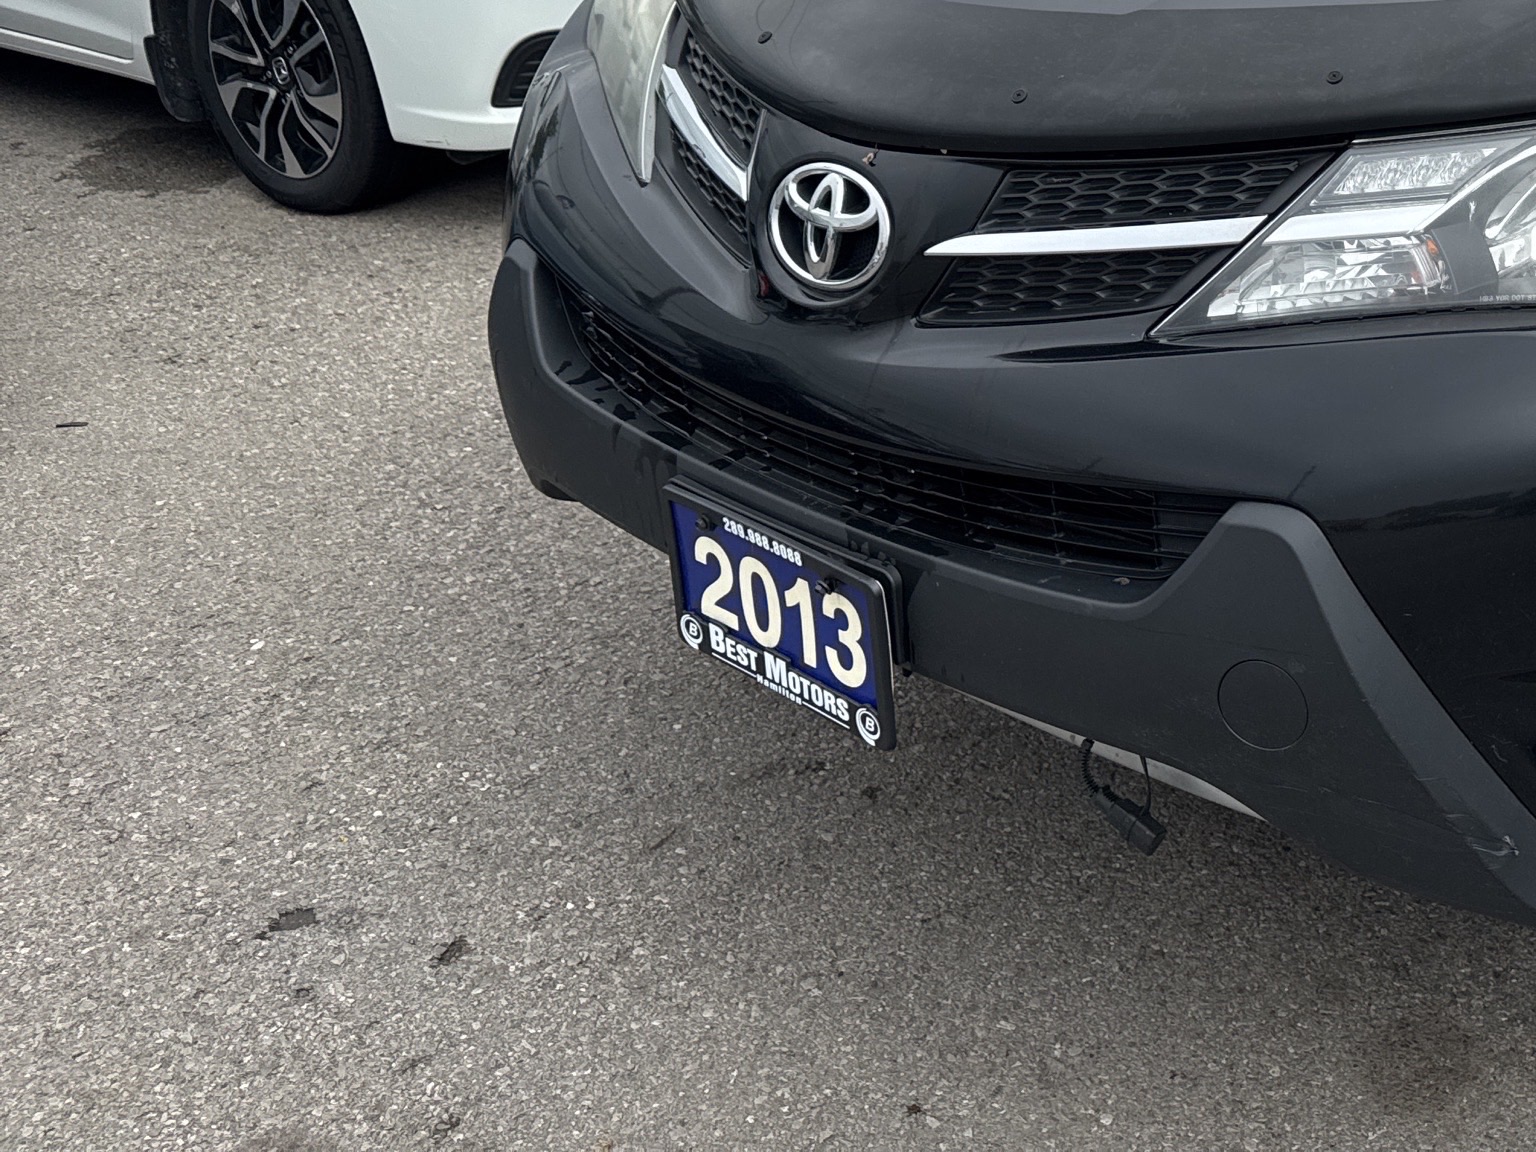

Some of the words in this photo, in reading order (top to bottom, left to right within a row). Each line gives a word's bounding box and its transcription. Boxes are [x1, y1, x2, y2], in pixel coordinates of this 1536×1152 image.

[722, 517, 803, 567] 289.988.8088
[694, 536, 867, 688] 2013
[708, 622, 758, 671] BEST
[763, 651, 850, 722] MOTORS
[756, 673, 803, 706] Hamilton
